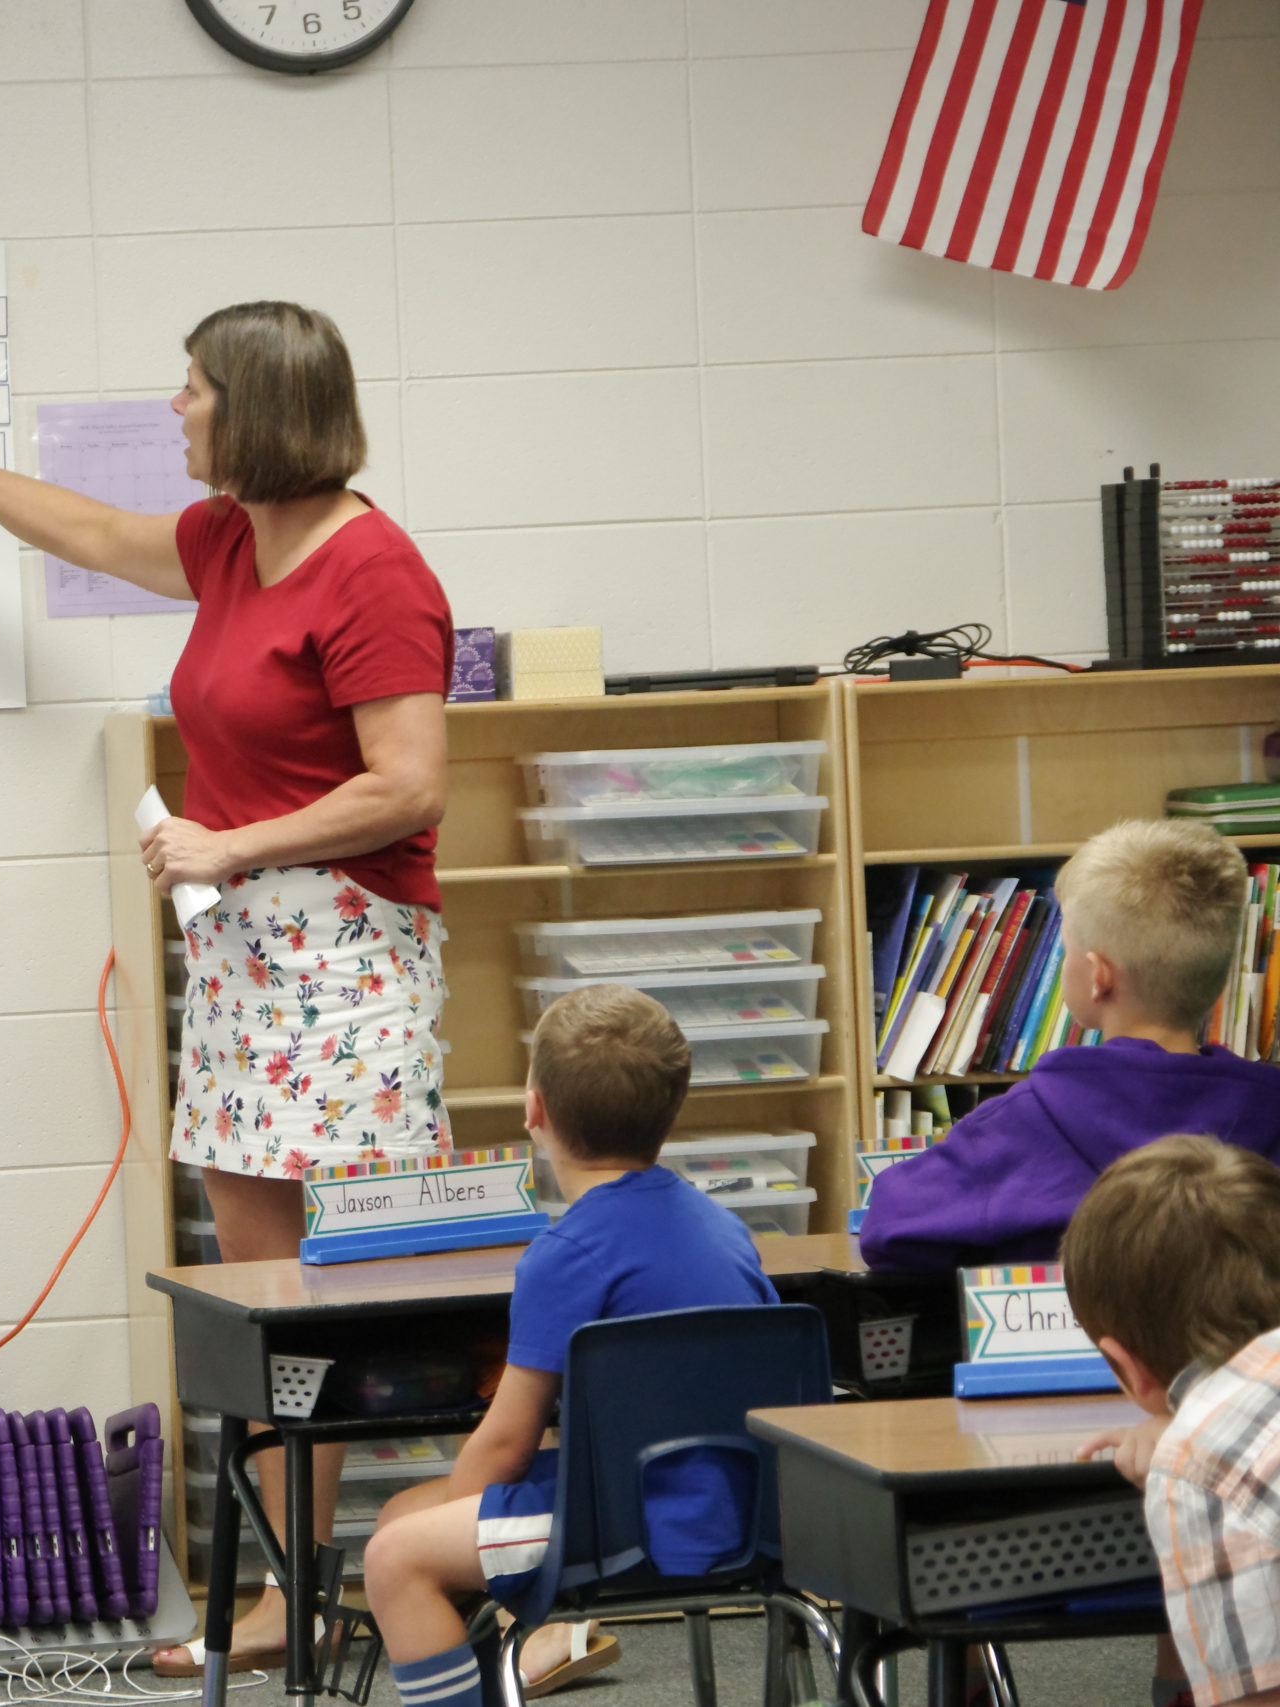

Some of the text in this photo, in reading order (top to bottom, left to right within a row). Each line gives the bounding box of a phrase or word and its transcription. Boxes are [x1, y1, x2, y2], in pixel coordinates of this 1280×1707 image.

[258, 0, 362, 34] 7 6 5
[336, 1175, 486, 1214] Jaxson Albers
